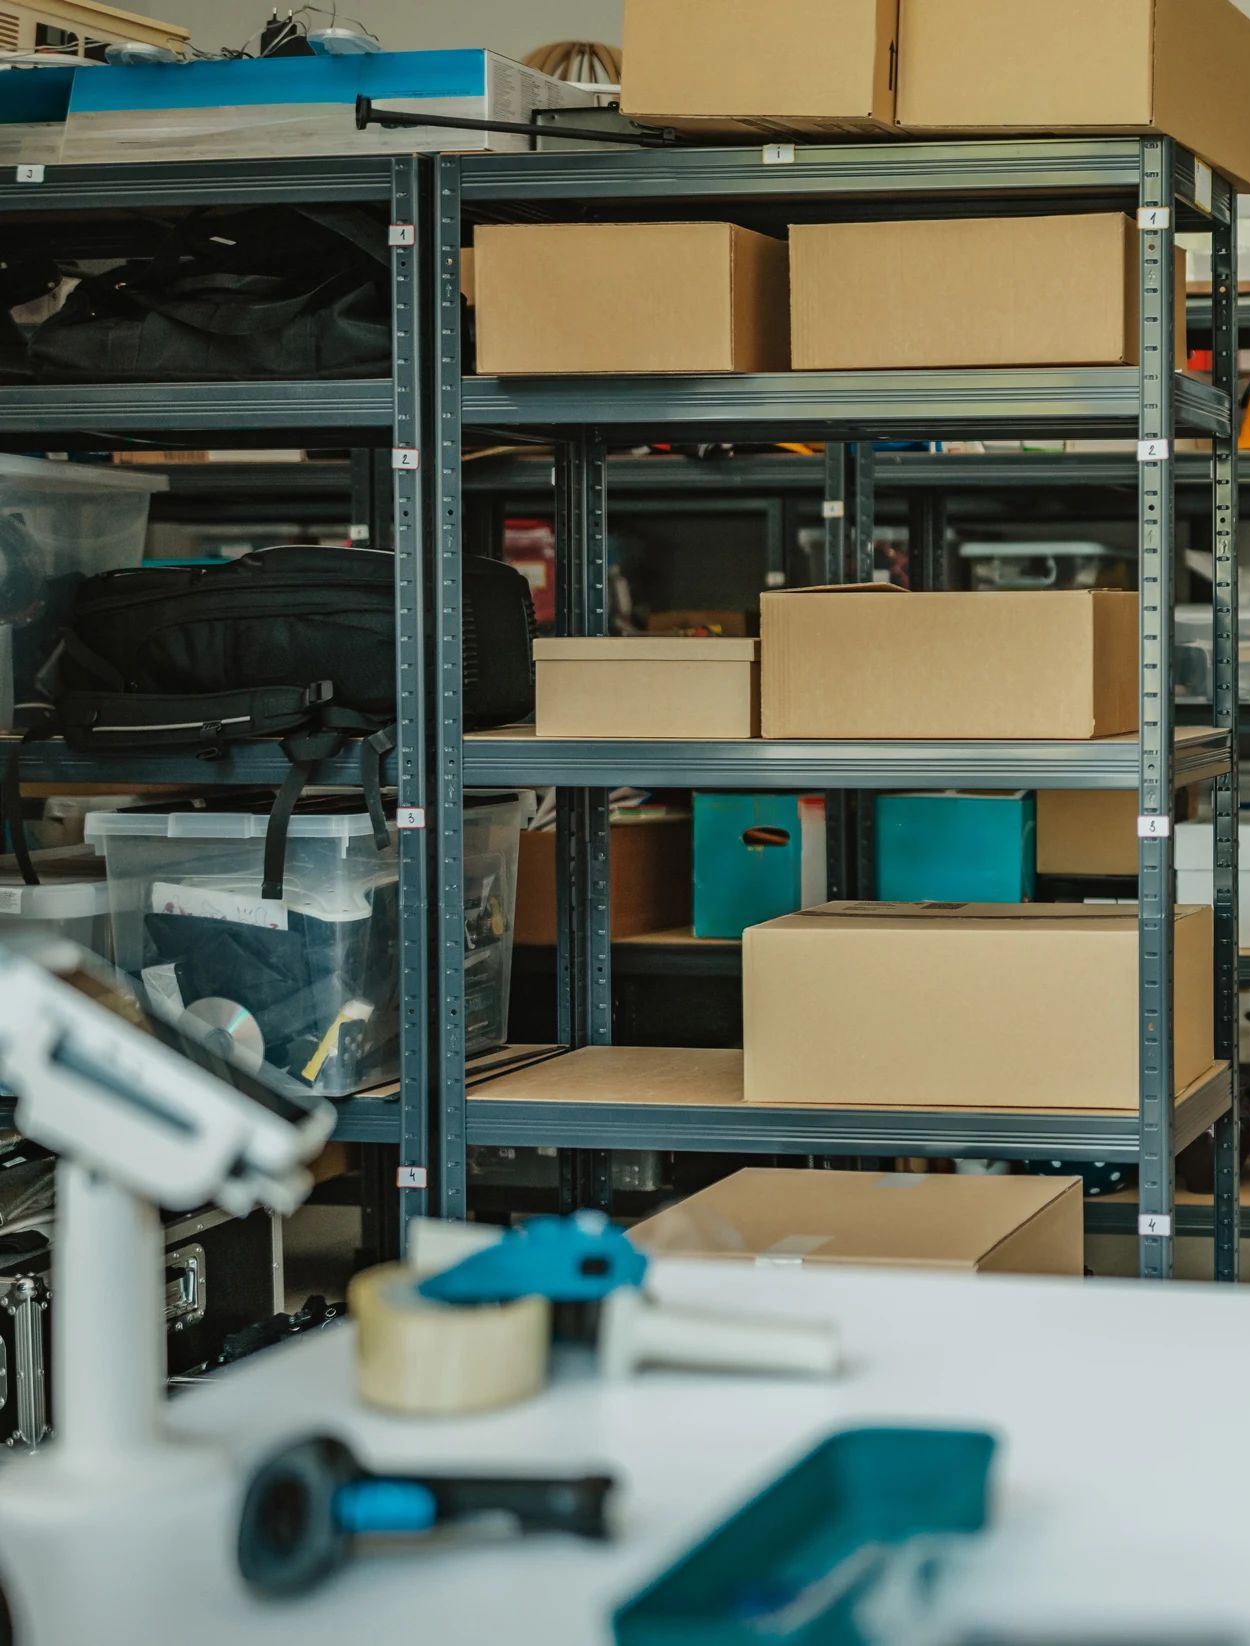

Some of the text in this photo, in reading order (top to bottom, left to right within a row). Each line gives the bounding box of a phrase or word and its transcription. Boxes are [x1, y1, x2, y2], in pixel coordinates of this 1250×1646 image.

[1150, 212, 1157, 225] 1
[400, 229, 406, 240] 1
[1148, 444, 1156, 456] 2
[402, 453, 410, 464] 2
[408, 812, 415, 824] 3
[1149, 820, 1156, 833] 3
[409, 1168, 416, 1182] 4
[1148, 1218, 1156, 1233] 4
